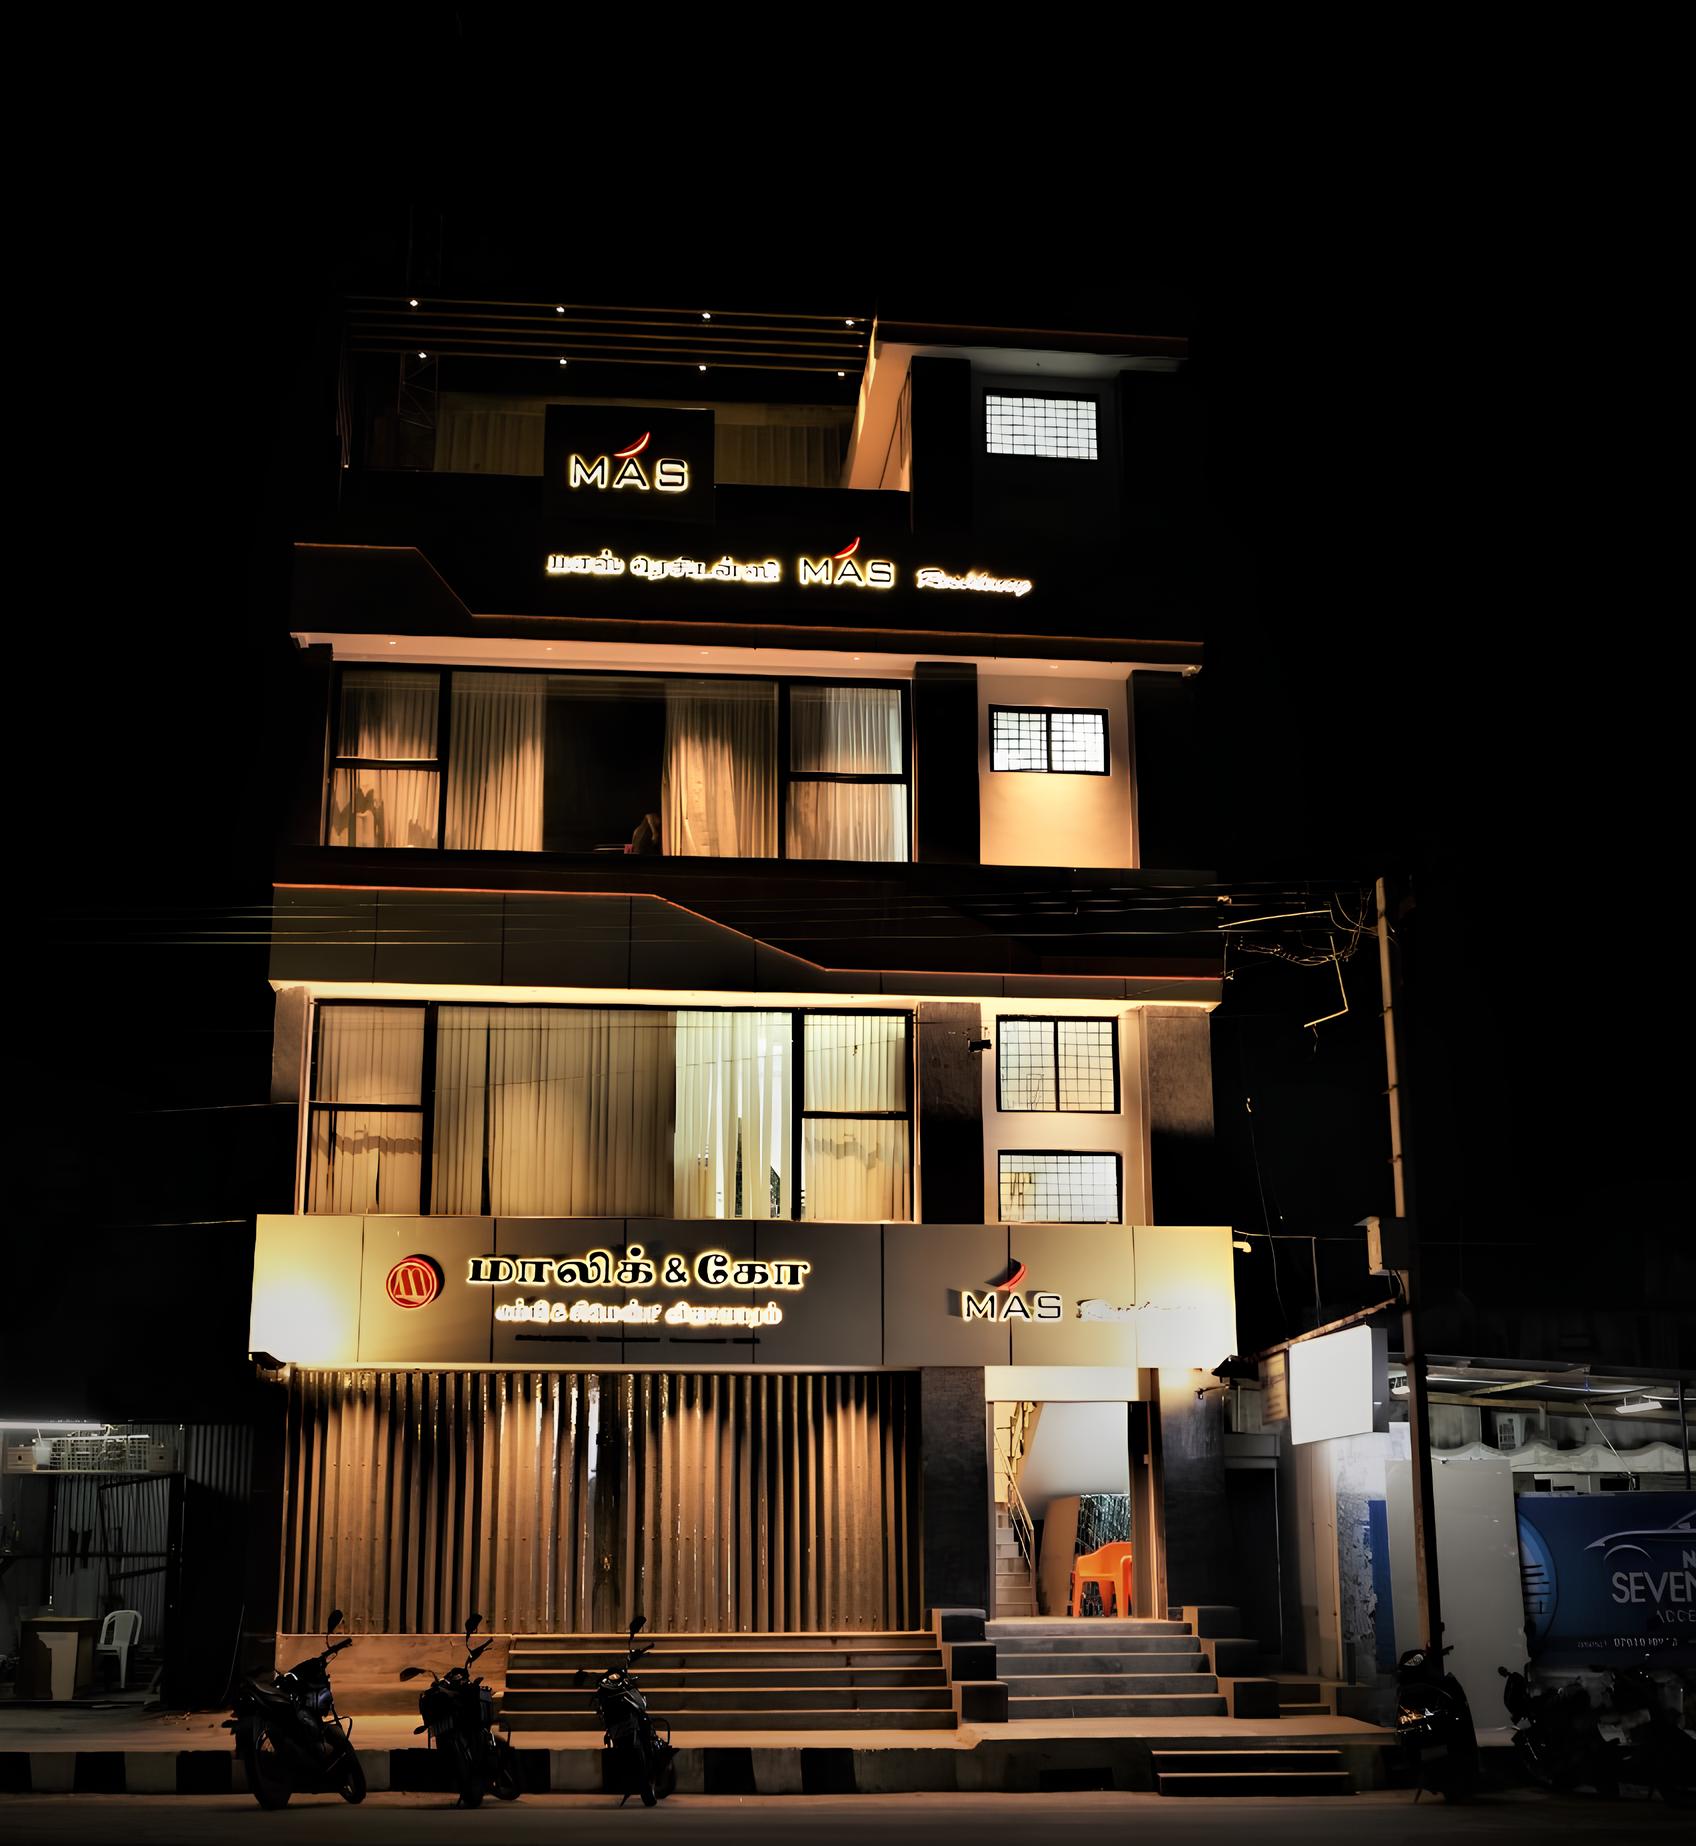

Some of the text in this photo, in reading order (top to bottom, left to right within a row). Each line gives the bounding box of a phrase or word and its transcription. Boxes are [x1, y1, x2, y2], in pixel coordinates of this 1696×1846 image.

[569, 453, 690, 492] MAS
[799, 556, 896, 588] MAS
[468, 1245, 811, 1290] மாலிக் & கோ
[962, 1291, 1063, 1322] MAS
